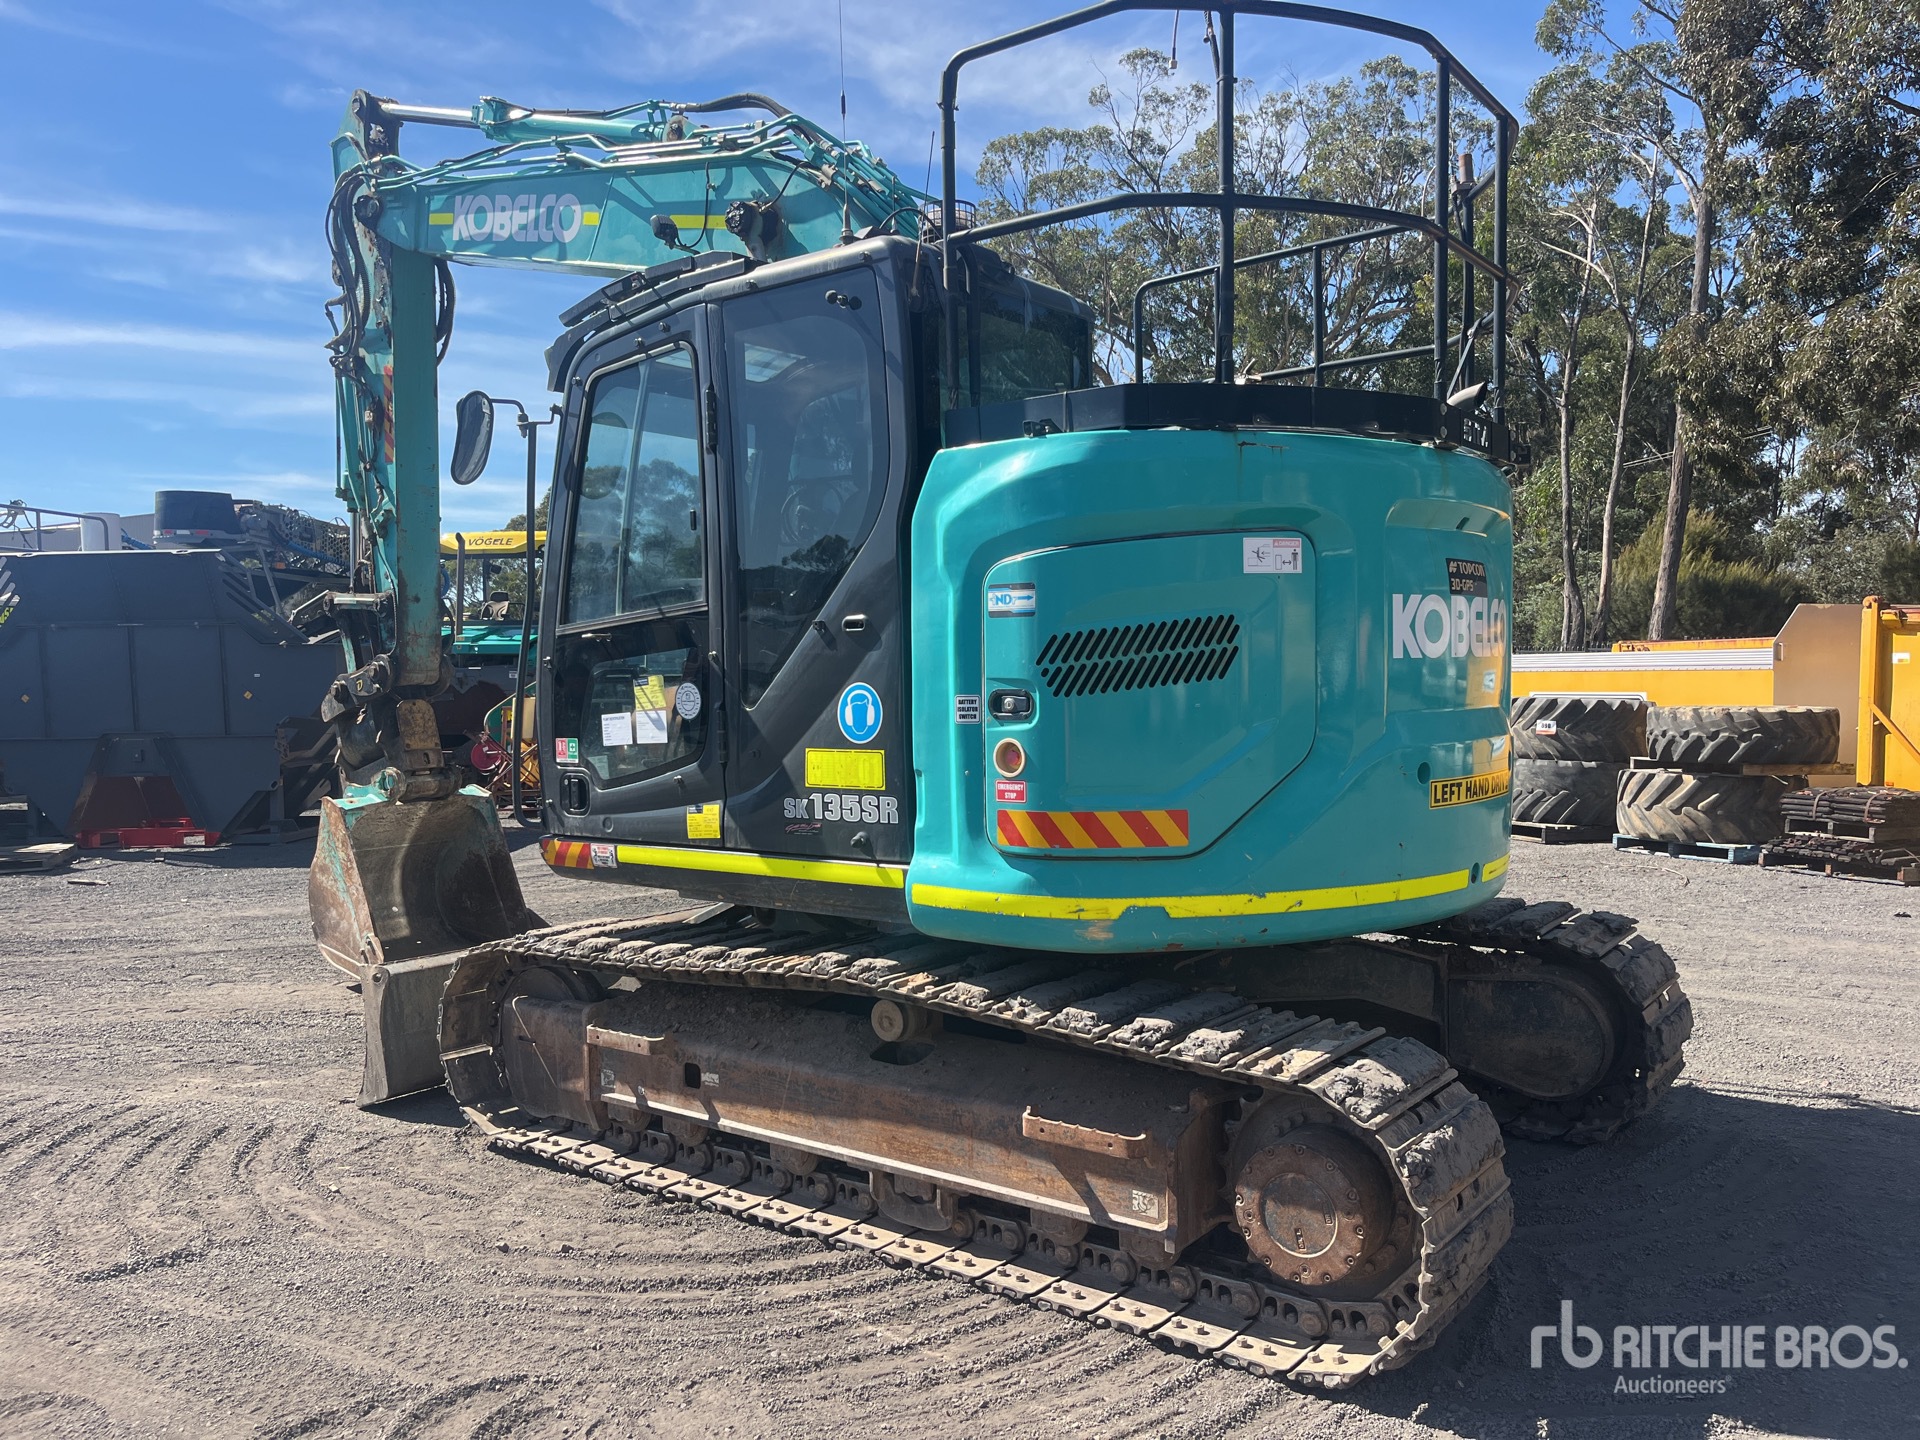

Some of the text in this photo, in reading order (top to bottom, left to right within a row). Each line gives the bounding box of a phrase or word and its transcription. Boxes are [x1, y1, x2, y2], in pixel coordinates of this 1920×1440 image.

[453, 194, 582, 243] KOBELCO
[1457, 561, 1485, 577] TOPCON
[1450, 578, 1474, 592] 3D-GPS
[1392, 593, 1507, 659] KOBELCO
[998, 783, 1024, 791] EMERGENCY
[1434, 782, 1463, 804] LEFT
[1465, 776, 1490, 800] HAND
[783, 793, 899, 824] SK135SR
